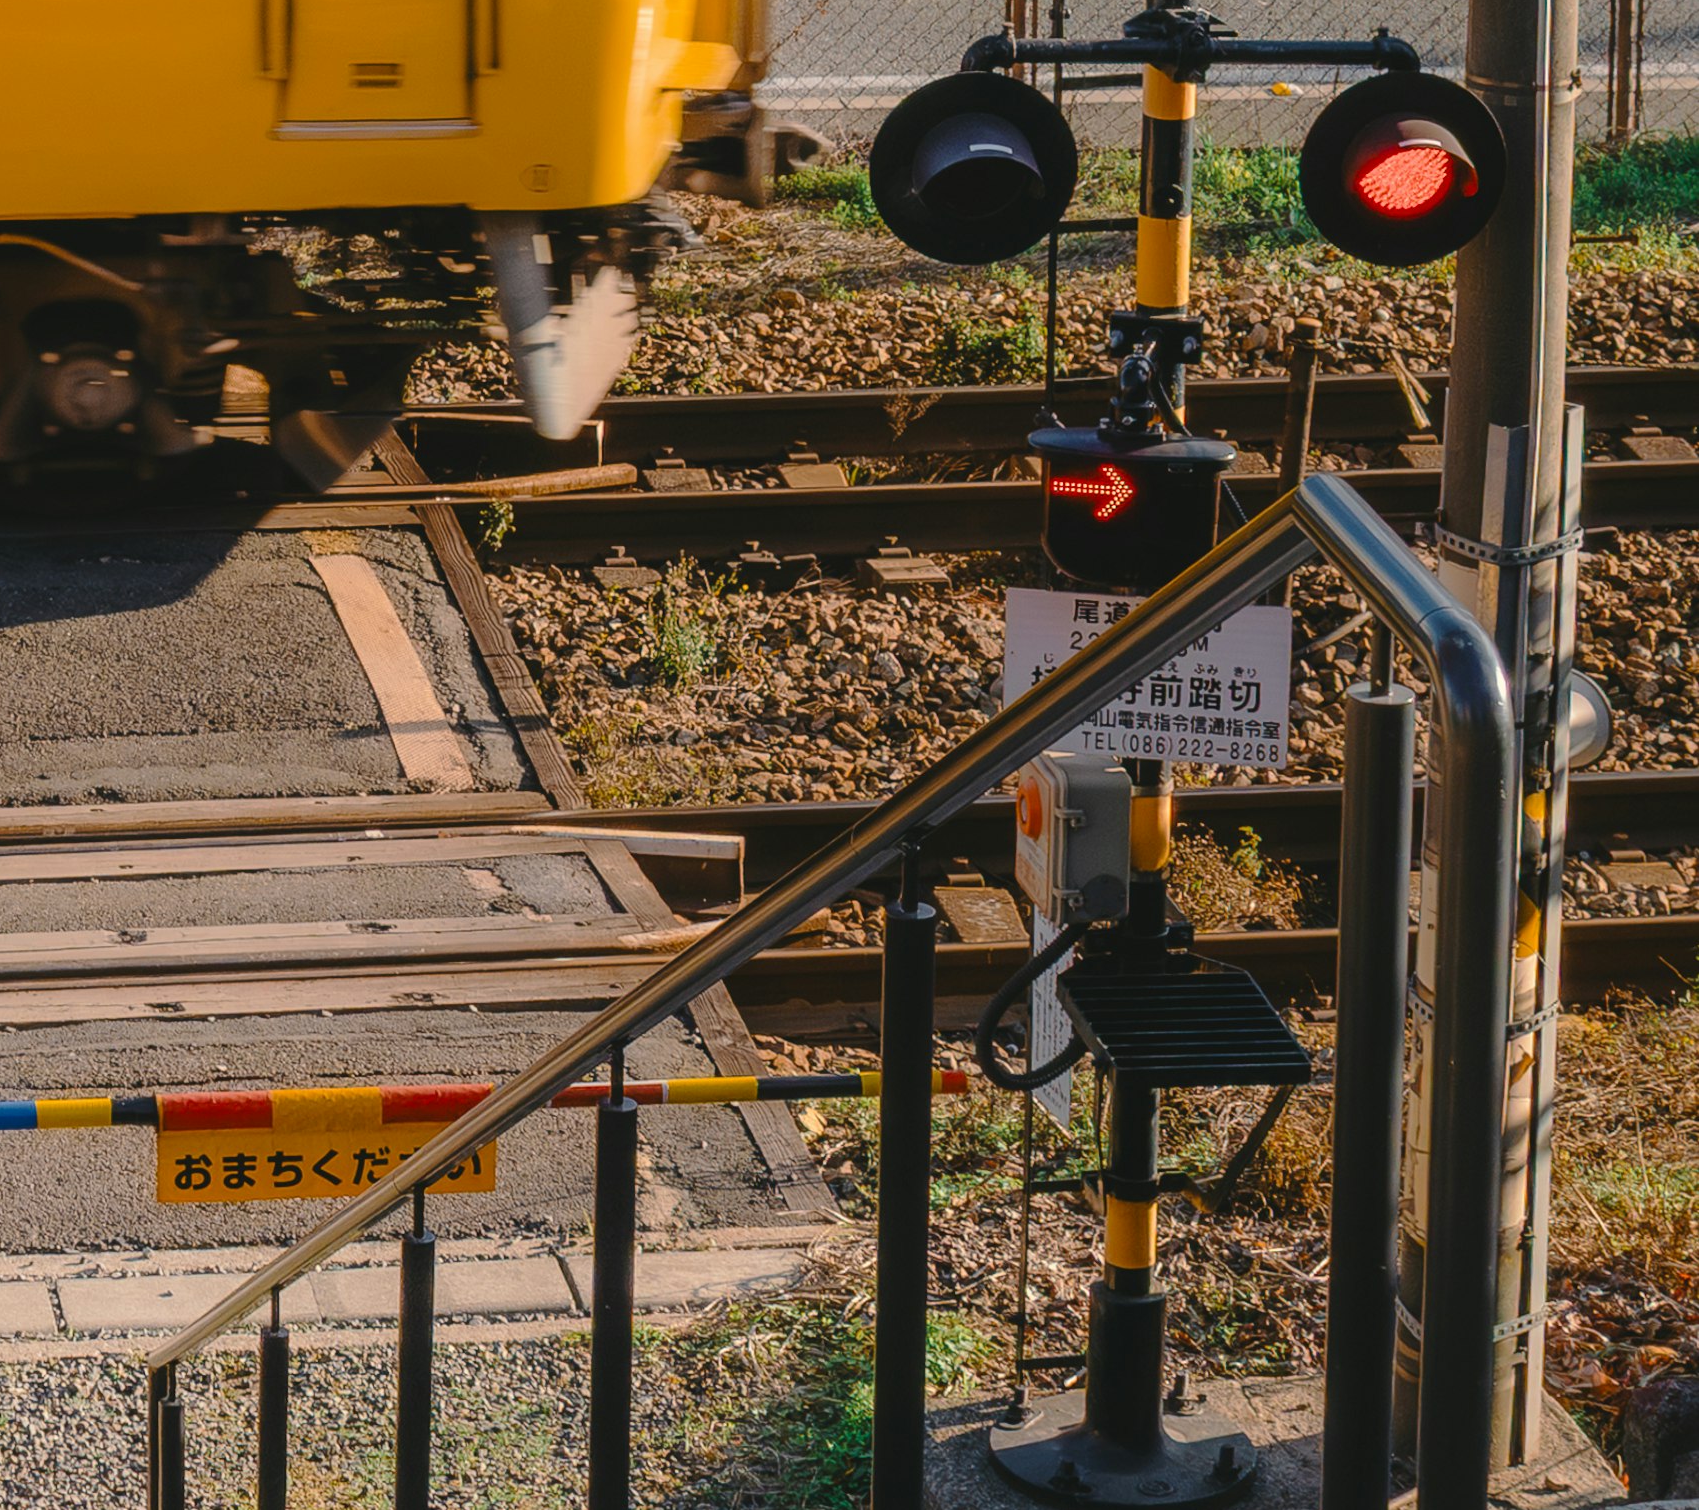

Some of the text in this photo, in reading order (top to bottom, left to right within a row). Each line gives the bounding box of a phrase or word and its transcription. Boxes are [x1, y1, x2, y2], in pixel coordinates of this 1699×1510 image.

[173, 1145, 483, 1191] おまちくだい
